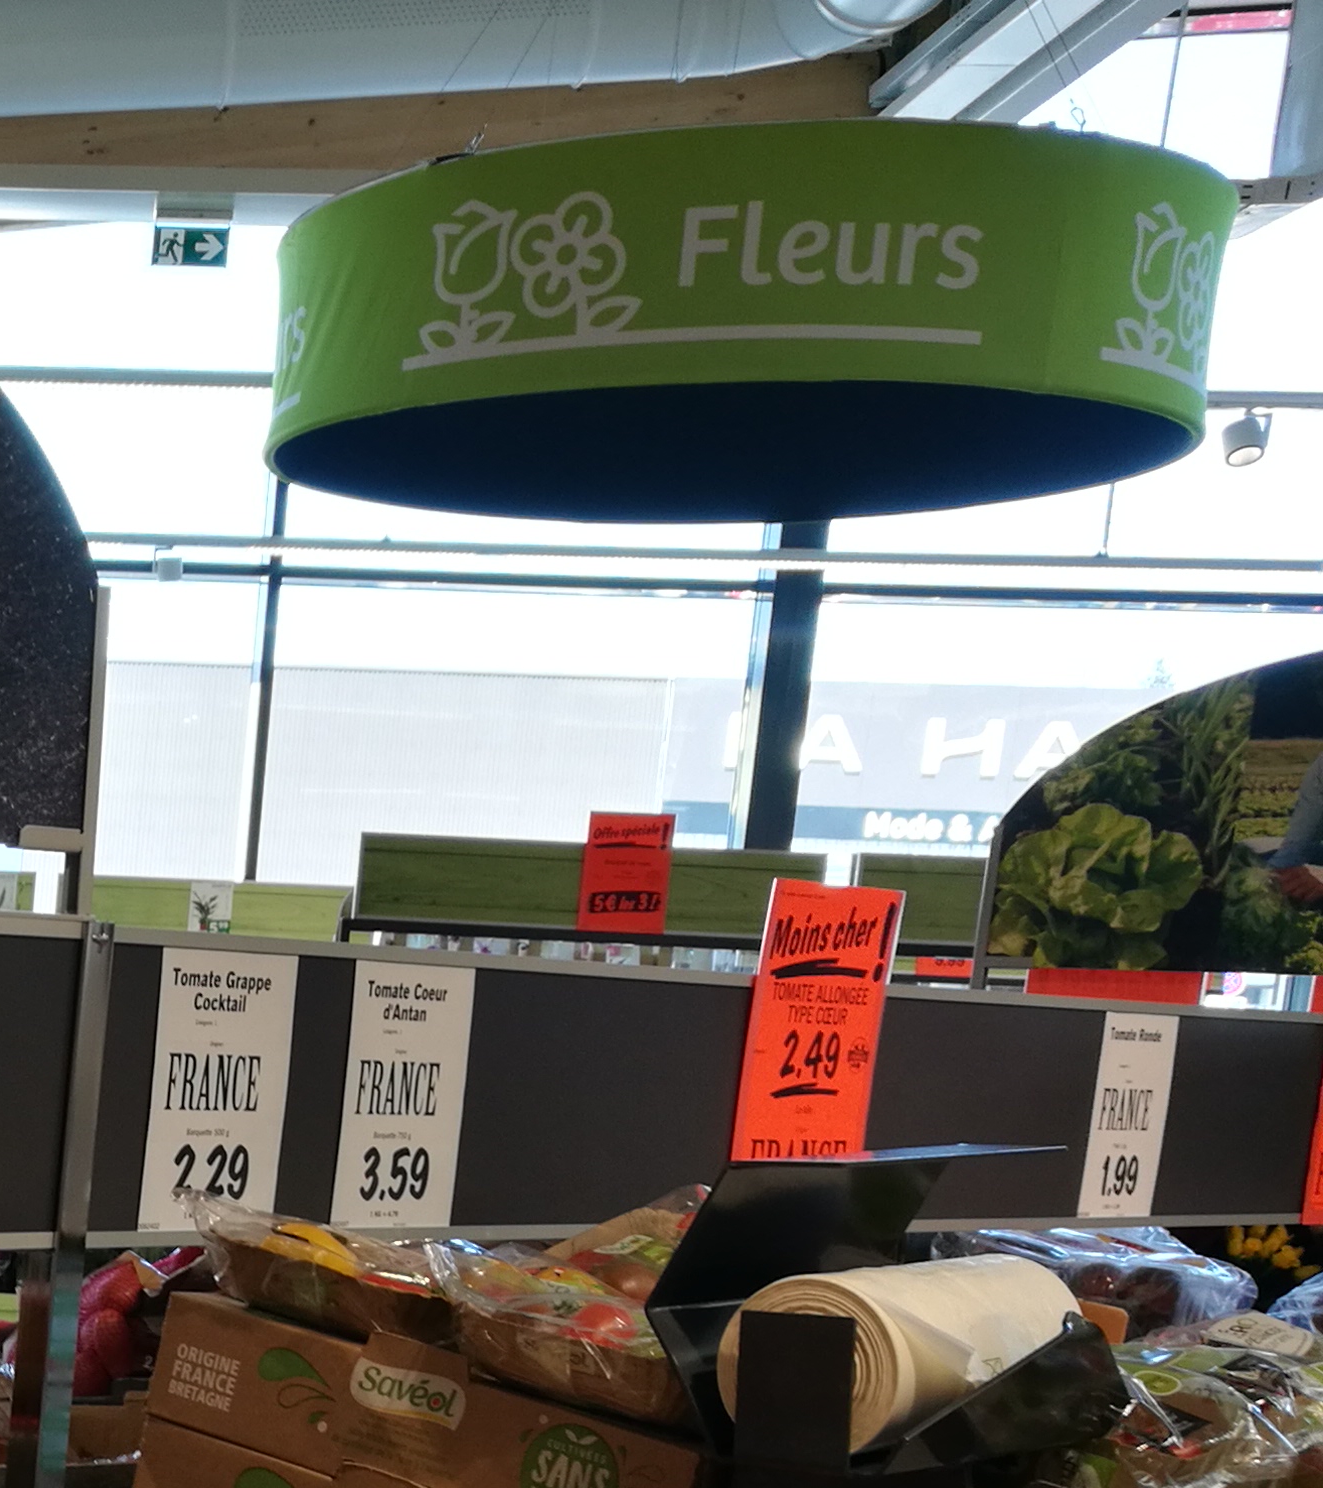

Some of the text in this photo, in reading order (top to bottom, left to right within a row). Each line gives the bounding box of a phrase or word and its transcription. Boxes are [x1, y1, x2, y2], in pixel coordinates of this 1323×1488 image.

[676, 201, 983, 291] Fleurs
[864, 810, 972, 842] Mode &
[770, 906, 877, 959] Moins cher
[173, 967, 272, 994] Tomate Grappe
[368, 980, 447, 1001] Tomate Coeur
[773, 981, 870, 1005] TOMATE ALLONGÉE
[194, 992, 247, 1013] Cocktail
[383, 1004, 427, 1022] d'Antan
[788, 1005, 813, 1024] TYPE
[1110, 1027, 1136, 1042] Tomate
[780, 1030, 841, 1079] 2.49
[164, 1052, 261, 1112] FRANCE
[355, 1060, 440, 1116] FRANCE
[1098, 1088, 1153, 1131] FRANCE
[173, 1144, 249, 1200] 229
[360, 1147, 429, 1201] 3.59
[1101, 1155, 1139, 1197] 1.99
[177, 1343, 241, 1376] ORIGINE
[173, 1360, 237, 1395] FRANCE
[358, 1365, 458, 1419] Savéol
[168, 1379, 232, 1413] BRETAGNE
